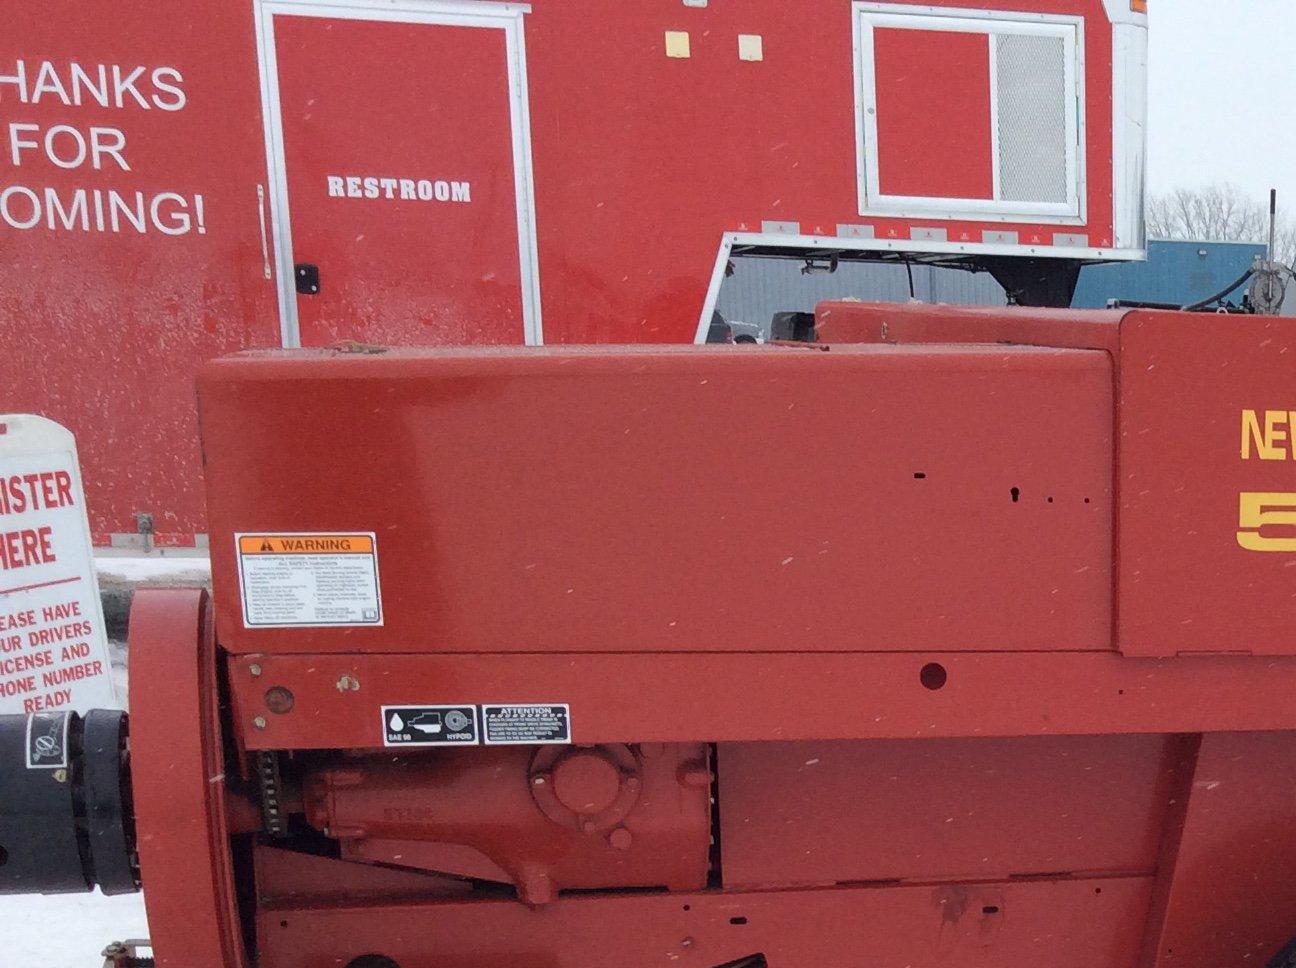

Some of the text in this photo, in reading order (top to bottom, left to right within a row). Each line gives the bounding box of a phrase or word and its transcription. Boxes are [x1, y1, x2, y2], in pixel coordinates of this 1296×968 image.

[8, 122, 132, 171] FOR
[327, 176, 472, 203] RESTROOM
[0, 186, 206, 236] OMING!
[0, 470, 75, 516] ISTER
[281, 539, 351, 551] WARNING
[42, 601, 82, 622] HAVE
[0, 620, 92, 653] UR DRIVERS
[61, 642, 90, 662] AND
[42, 660, 103, 687] NUMBER
[24, 688, 72, 714] READY
[501, 707, 552, 715] ATTENTION
